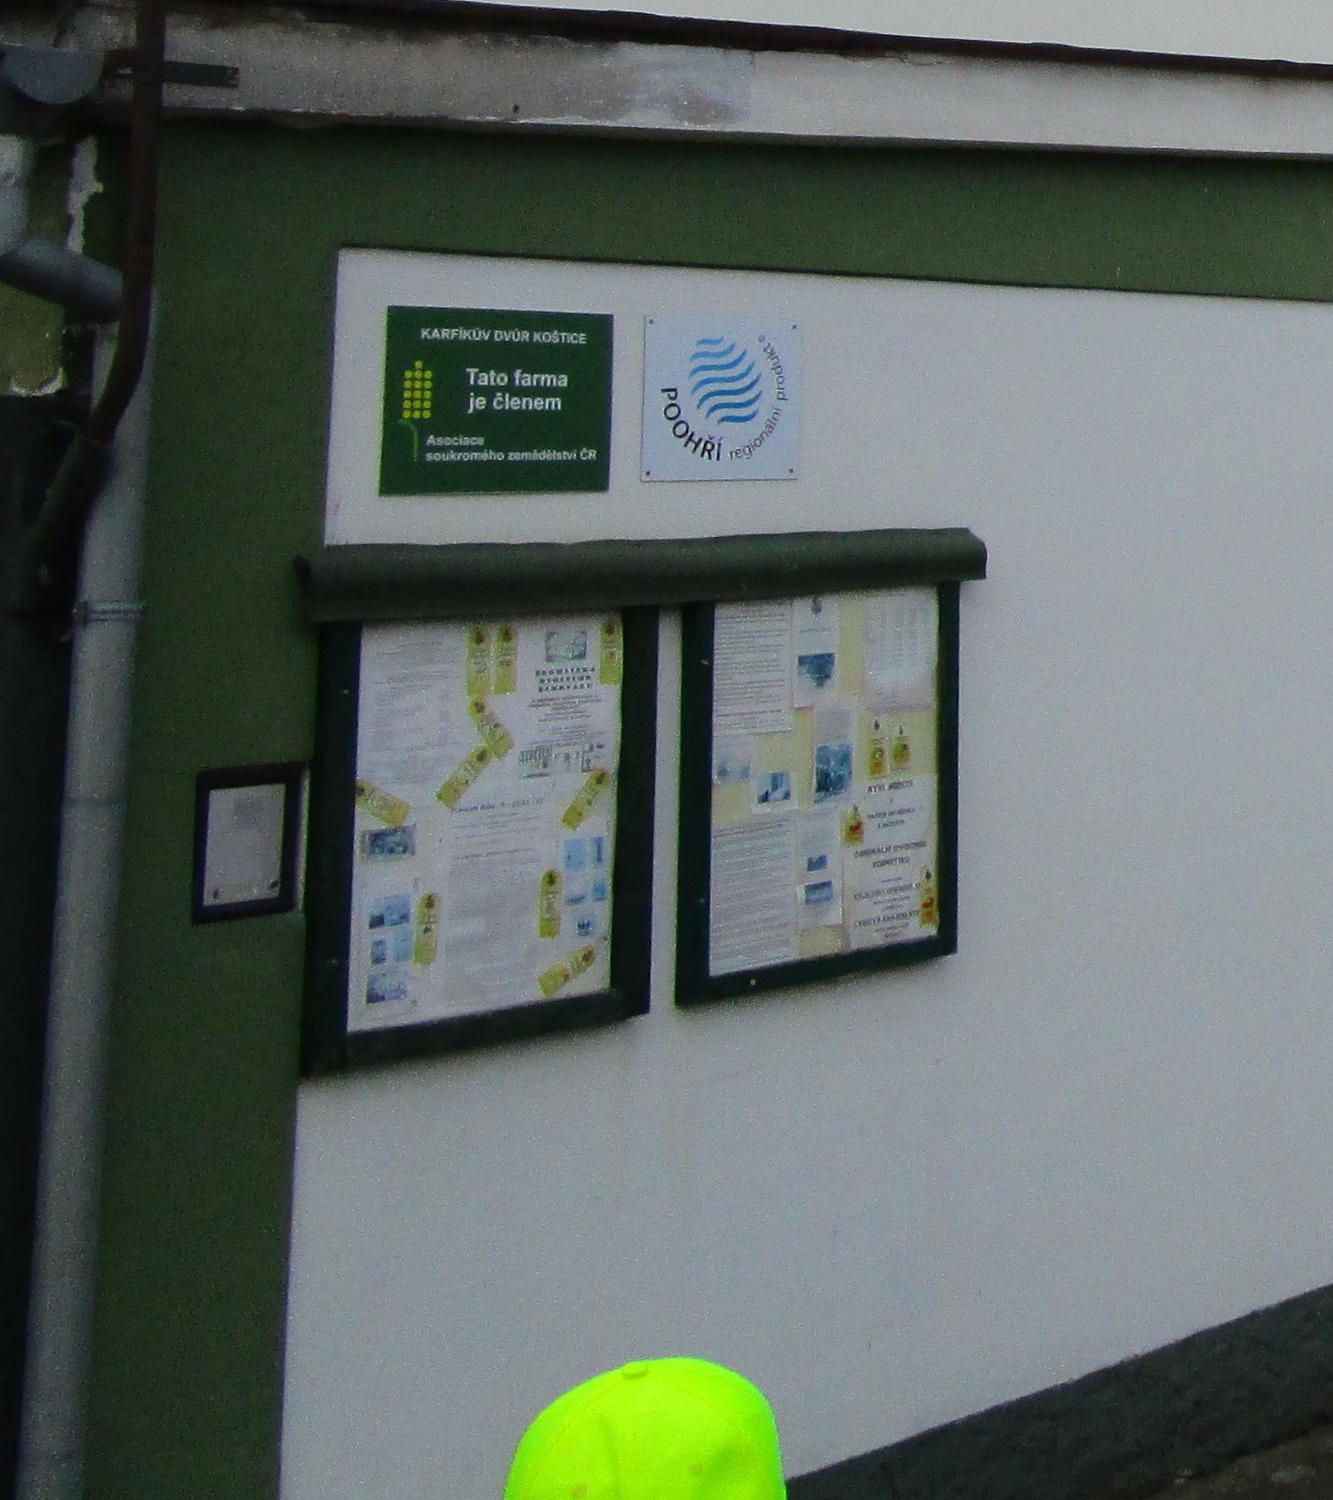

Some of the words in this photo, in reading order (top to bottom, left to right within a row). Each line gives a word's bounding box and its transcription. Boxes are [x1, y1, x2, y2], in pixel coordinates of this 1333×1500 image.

[421, 326, 491, 341] KARFÍKŮV
[494, 328, 530, 342] DVŮR
[533, 329, 587, 345] KOŠTICE
[465, 368, 508, 386] Tato
[513, 369, 568, 387] farma
[467, 392, 486, 414] je
[493, 392, 562, 411] členem
[729, 407, 782, 460] regionální
[763, 342, 789, 401] produkt
[661, 387, 723, 461] POOHŘÍ
[426, 434, 484, 446] Asociace
[426, 448, 504, 462] soukromého
[507, 448, 577, 461] zemědělství
[580, 447, 597, 461] ČR
